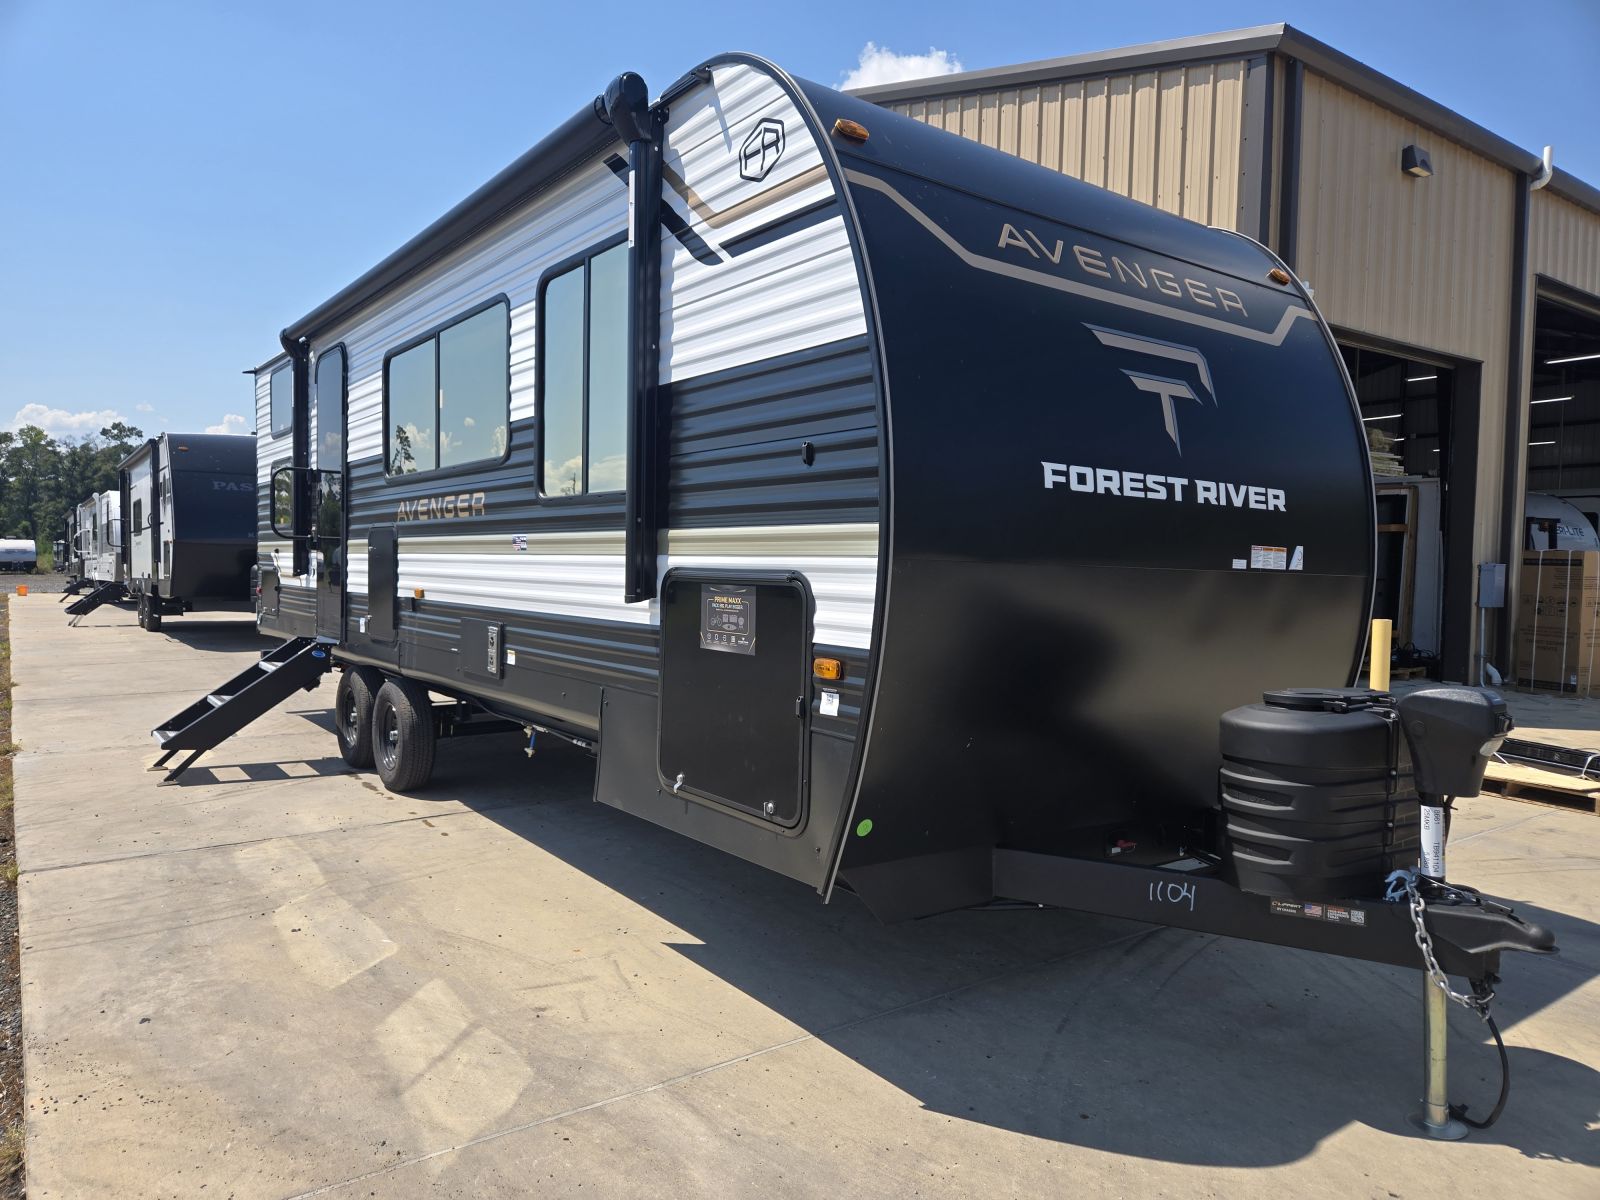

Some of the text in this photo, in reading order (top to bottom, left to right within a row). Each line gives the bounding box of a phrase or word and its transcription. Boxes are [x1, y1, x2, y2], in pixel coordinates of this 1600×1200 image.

[997, 223, 1249, 318] AVENGER
[396, 491, 486, 523] AVENGER
[1040, 461, 1287, 512] FOREST RIVER
[1149, 880, 1196, 911] 1104
